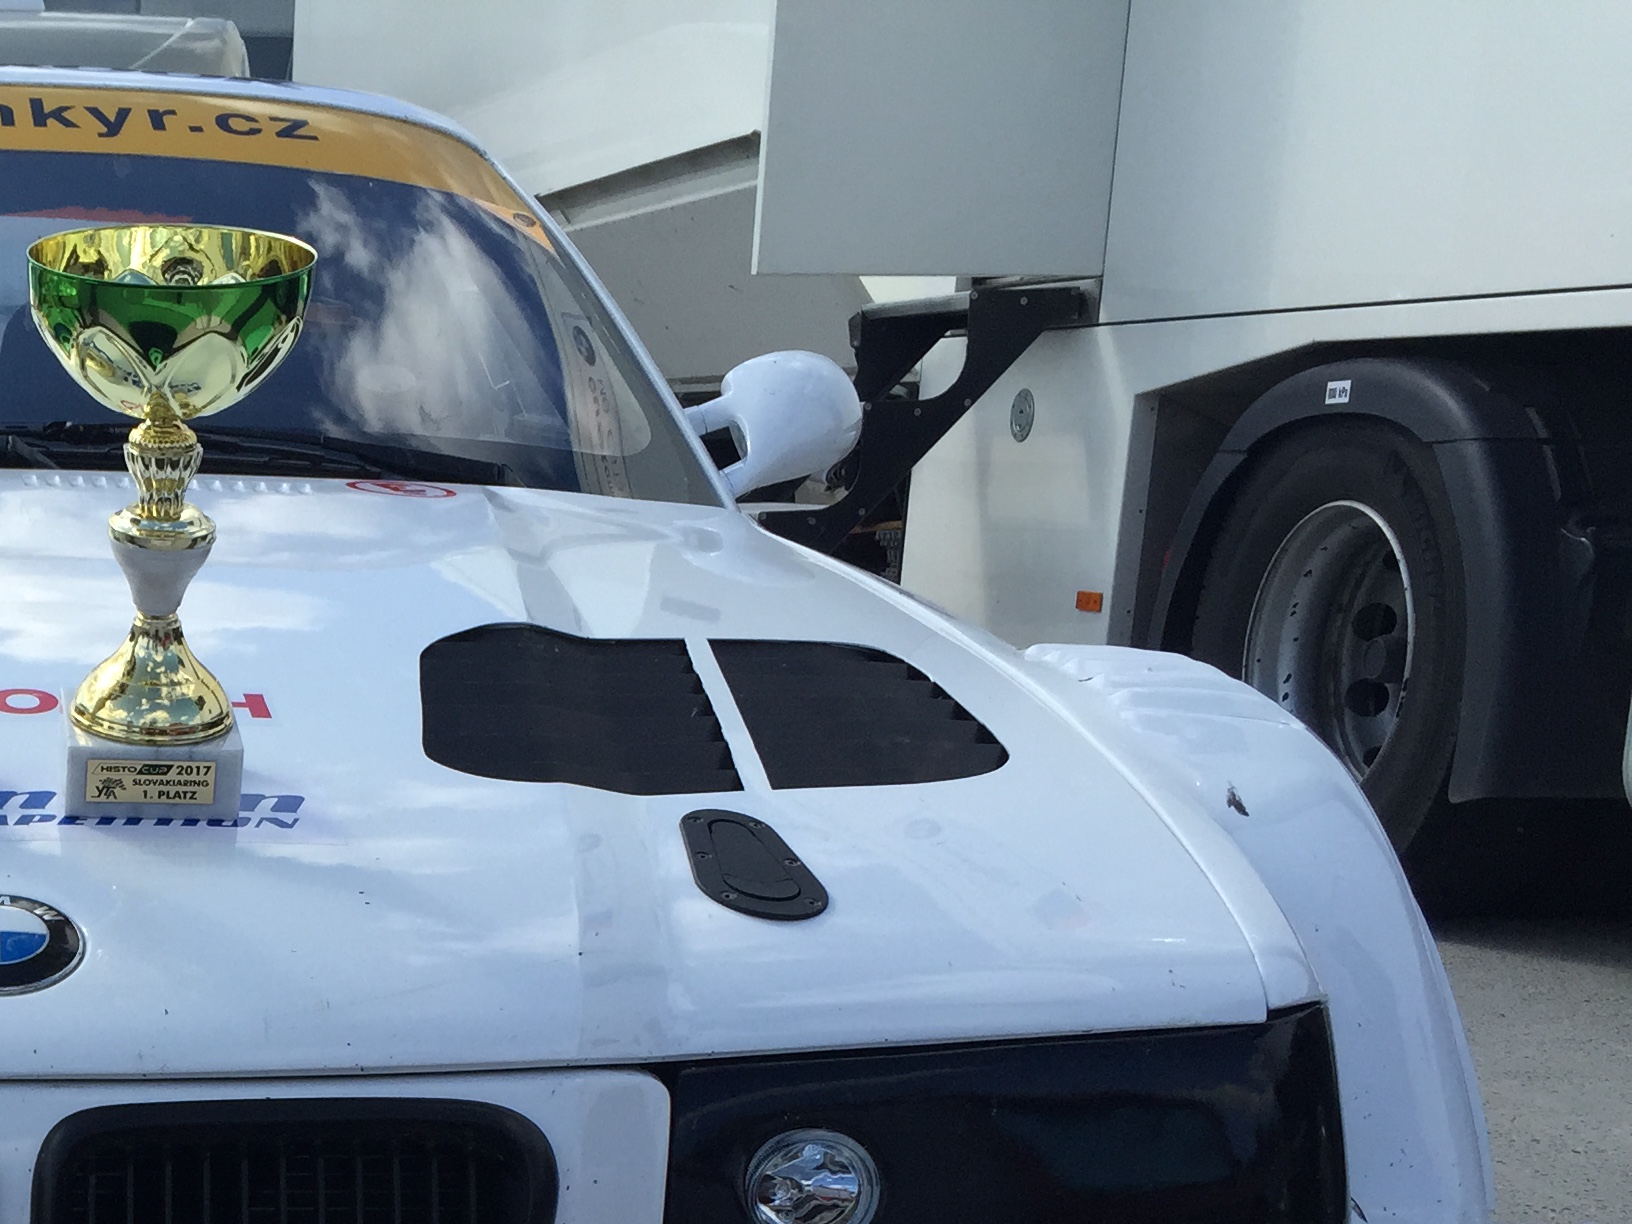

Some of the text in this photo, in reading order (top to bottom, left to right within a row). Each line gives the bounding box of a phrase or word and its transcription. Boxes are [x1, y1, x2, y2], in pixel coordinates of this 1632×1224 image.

[141, 766, 169, 774] CUP
[175, 765, 212, 776] 2017
[131, 778, 210, 788] SLOVAKIARING
[142, 789, 198, 801] 1. PLATZ
